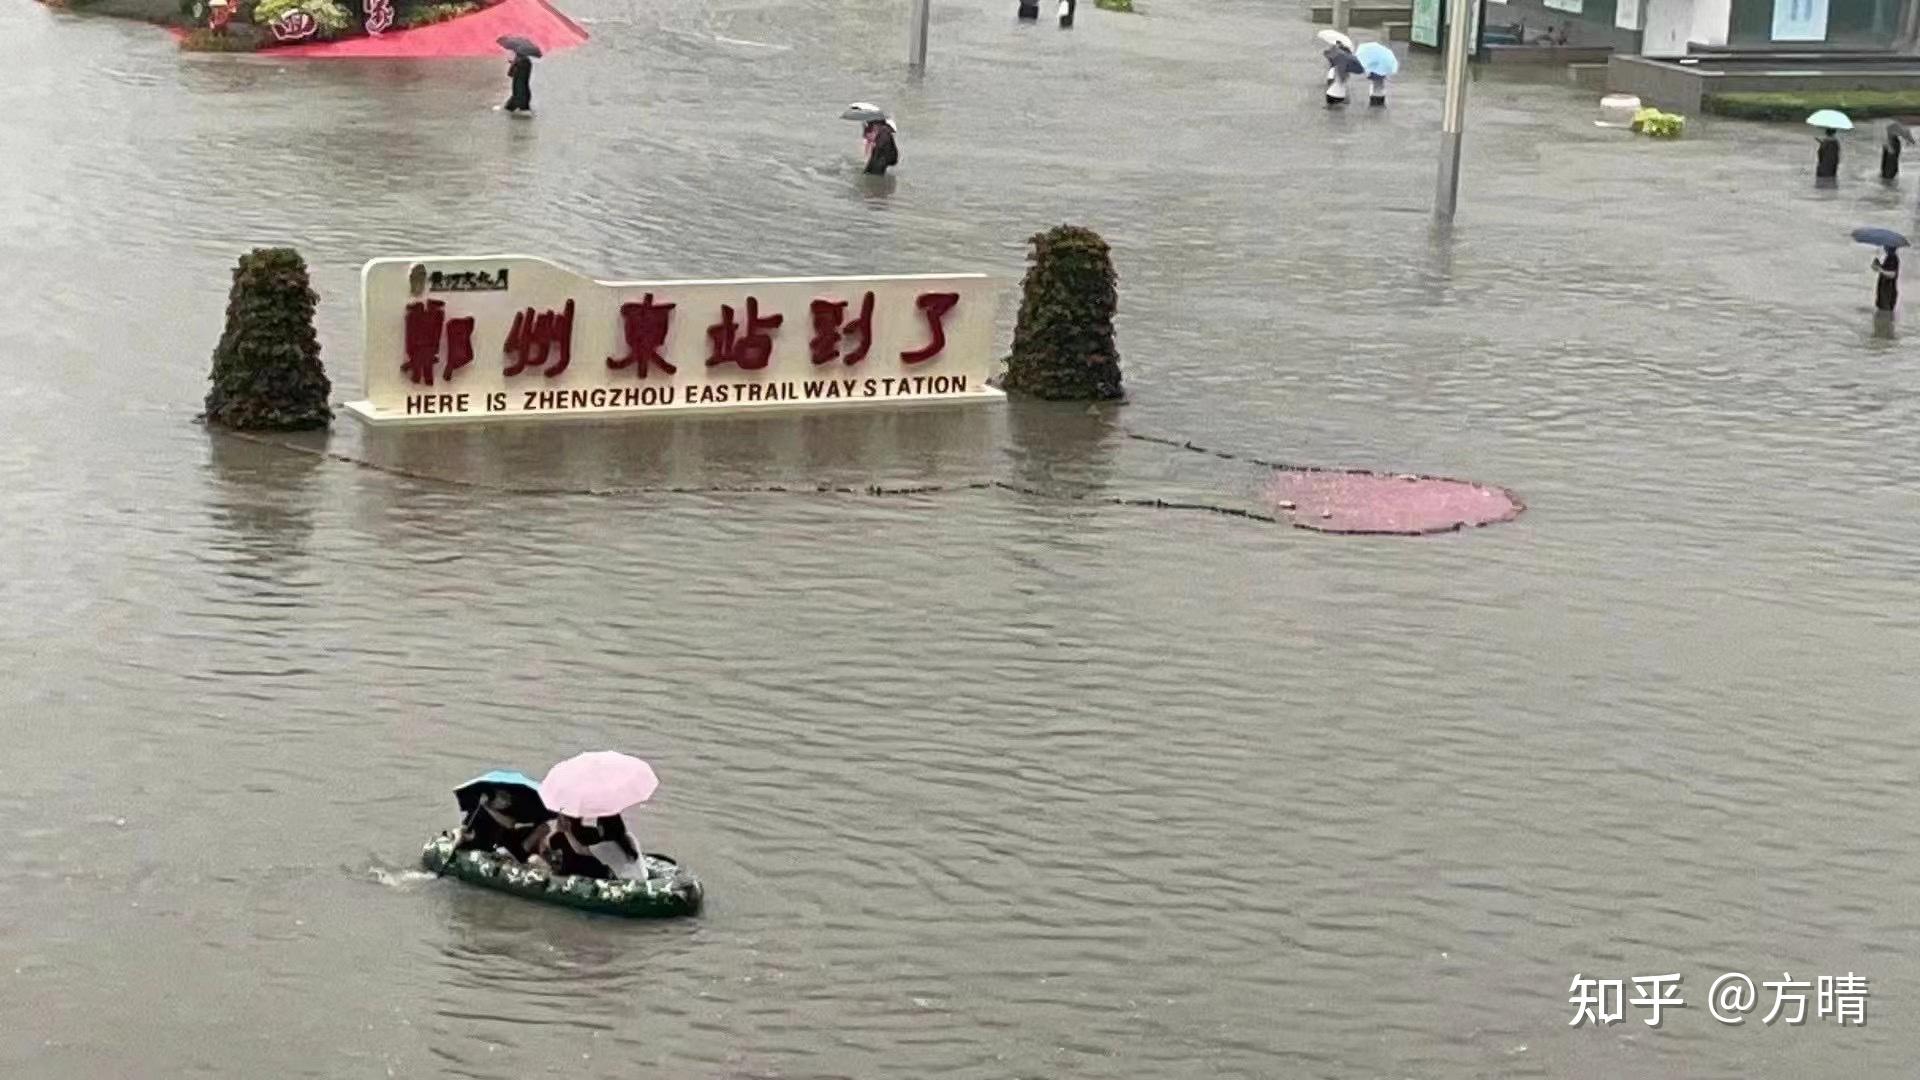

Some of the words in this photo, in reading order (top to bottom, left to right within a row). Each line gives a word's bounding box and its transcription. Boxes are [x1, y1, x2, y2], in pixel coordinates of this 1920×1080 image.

[406, 393, 469, 414] HERE
[487, 392, 507, 411] IS
[523, 386, 675, 409] ZHENGZHOU
[863, 375, 967, 397] STATION
